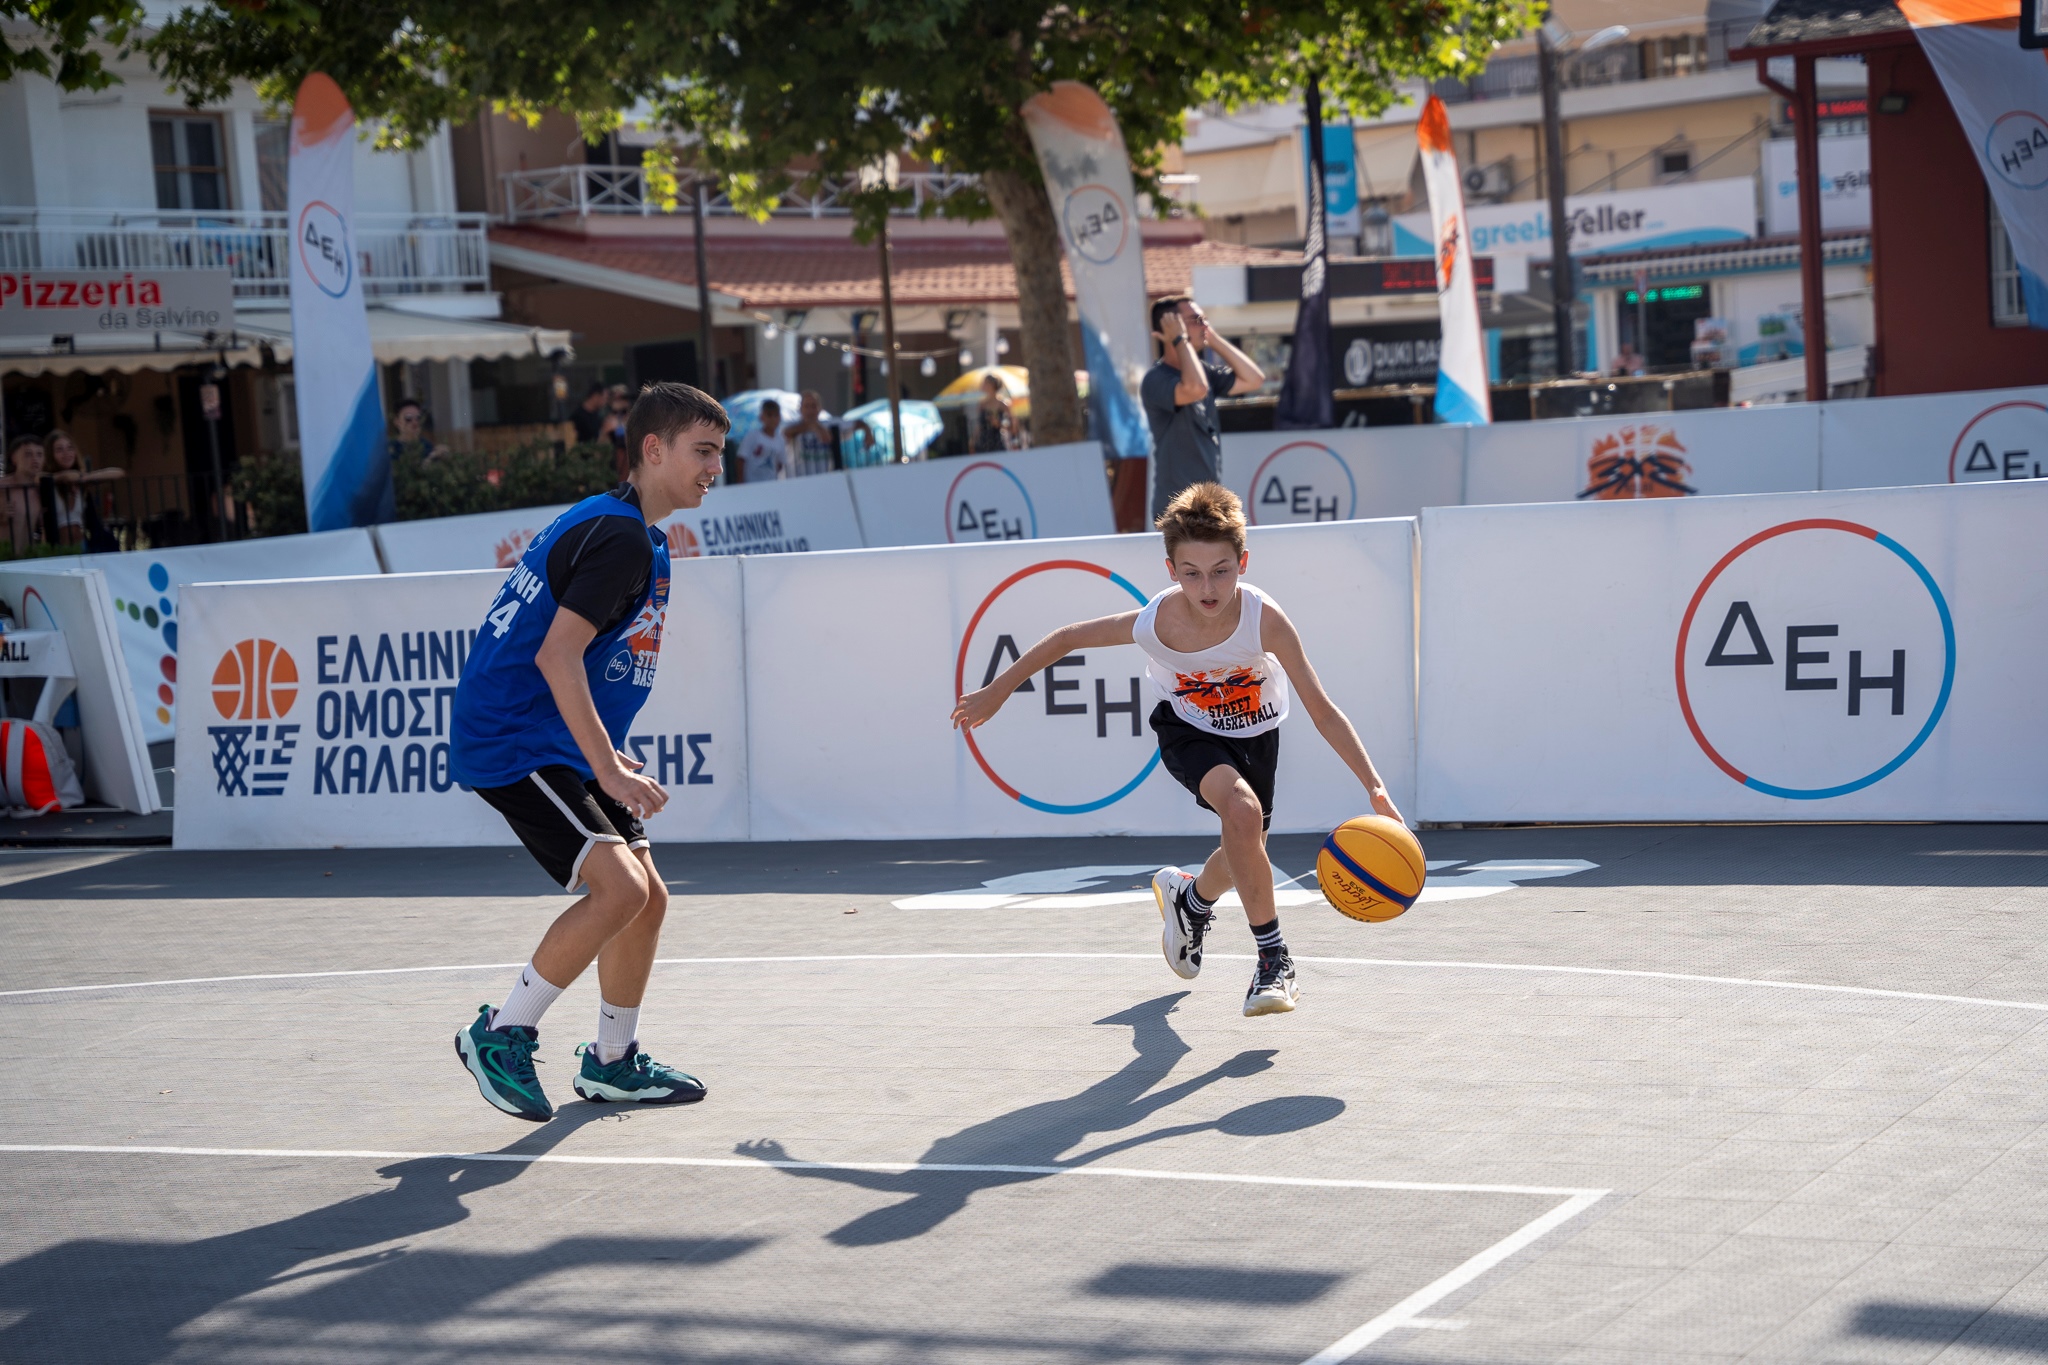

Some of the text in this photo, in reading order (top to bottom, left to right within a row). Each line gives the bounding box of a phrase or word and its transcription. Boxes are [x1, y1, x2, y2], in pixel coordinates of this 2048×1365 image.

[305, 221, 344, 277] ΔΕΗ
[0, 273, 162, 309] Pizzeria
[99, 307, 220, 329] da Salvino
[1261, 475, 1338, 521] ΔΕΗ
[700, 510, 784, 547] ΕΛΛΗΝΙΚΗ
[956, 500, 1023, 540] ΔΕΗ
[610, 658, 628, 673] ΔΕΗ
[1705, 601, 1905, 716] ΔΕΗ
[982, 634, 1142, 738] ΔΕΗ
[1208, 695, 1251, 718] STREET
[1211, 702, 1279, 731] BASKETBALL
